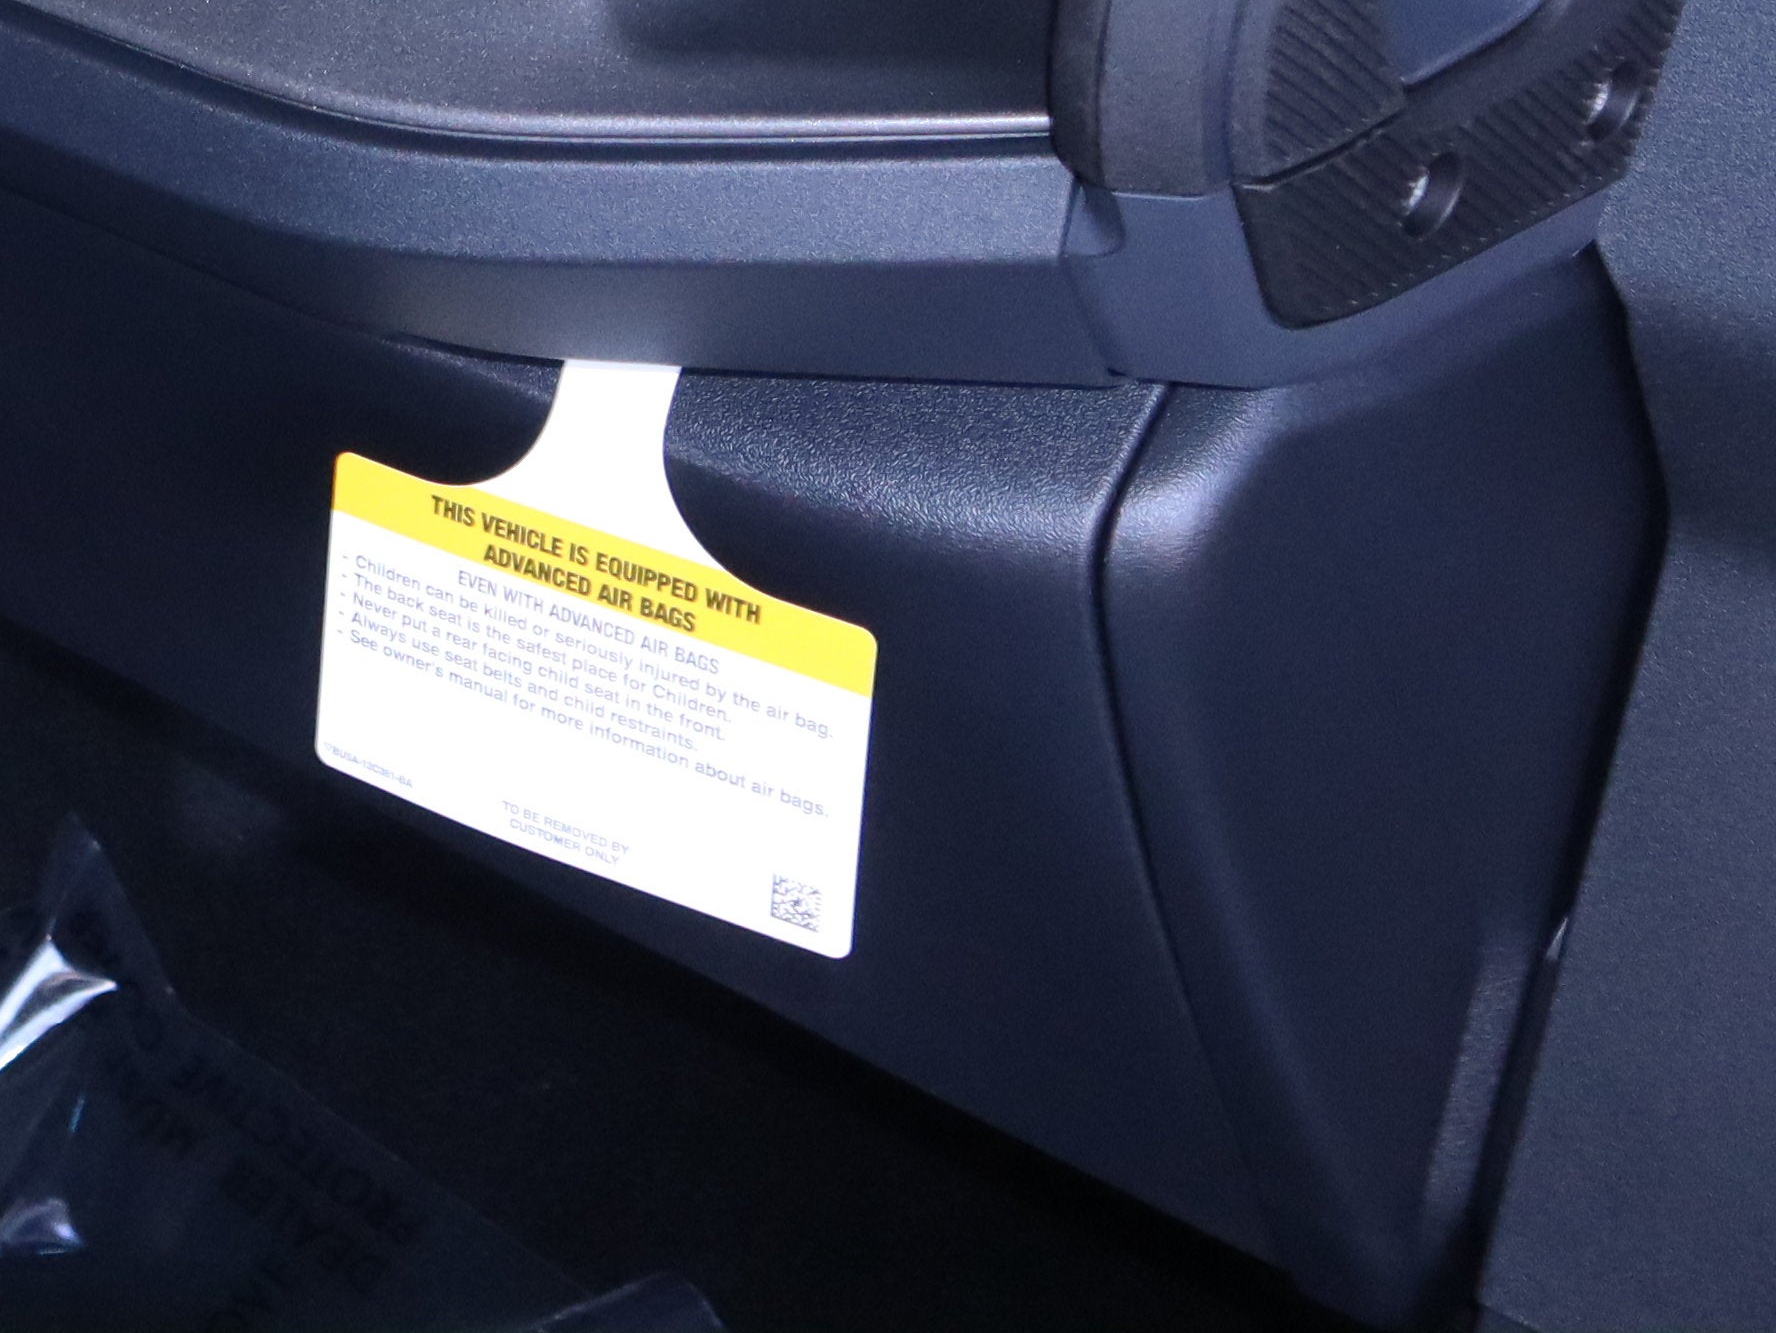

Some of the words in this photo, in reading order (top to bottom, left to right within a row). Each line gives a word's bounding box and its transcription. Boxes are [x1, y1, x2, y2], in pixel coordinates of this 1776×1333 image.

[431, 494, 475, 527] THIS
[481, 512, 563, 558] VEHICLE
[569, 543, 589, 566] IS
[595, 551, 699, 603] EQUIPPED
[705, 587, 762, 625] WITH
[458, 569, 498, 597] EVEN
[503, 585, 543, 614] WITH
[549, 601, 636, 645] ADVANCED
[640, 635, 670, 657] AIR
[674, 646, 721, 675] BAGS
[483, 543, 592, 597] ADVANCED
[597, 583, 633, 612] AIR
[639, 598, 697, 633] BAGS
[351, 611, 407, 643] Always
[411, 637, 440, 657] use
[444, 650, 479, 673] seat
[482, 661, 523, 689] belts
[527, 680, 559, 702] and
[563, 692, 606, 719] child
[610, 709, 699, 752] restraints.
[352, 591, 398, 620] Never
[401, 613, 428, 631] put
[431, 624, 442, 639] a
[446, 631, 478, 651] rear
[482, 642, 533, 676] facing
[537, 662, 579, 690] child
[584, 680, 620, 705] seat
[625, 693, 641, 711] in
[646, 701, 674, 723] the
[679, 712, 726, 741] front.
[354, 572, 382, 596] The
[387, 586, 424, 613] back
[429, 604, 462, 627] seat
[467, 617, 481, 634] is
[486, 624, 512, 645] the
[516, 638, 567, 665] safest
[572, 657, 617, 683] place
[623, 673, 647, 693] for
[652, 683, 732, 723] Children.
[355, 555, 421, 591] Children
[425, 583, 454, 604] can
[459, 594, 479, 613] be
[484, 603, 527, 631] killed
[532, 625, 549, 640] or
[555, 632, 634, 671] seriously
[639, 654, 700, 692] injured
[705, 682, 727, 704] by
[732, 691, 761, 712] the
[766, 706, 790, 721] air
[794, 712, 834, 739] bag.
[349, 629, 379, 651] See
[382, 643, 445, 678] owner's
[448, 671, 508, 703] manual
[512, 693, 536, 713] for
[540, 706, 584, 731] more
[589, 722, 690, 769] information
[694, 759, 747, 789] about
[750, 780, 775, 798] air
[779, 788, 830, 818] bags.
[502, 799, 520, 815] TO
[522, 808, 540, 824] BE
[543, 815, 608, 848] REMOVED
[611, 841, 630, 855] BY
[509, 817, 582, 852] CUSTOMER
[584, 846, 621, 866] ONLY
